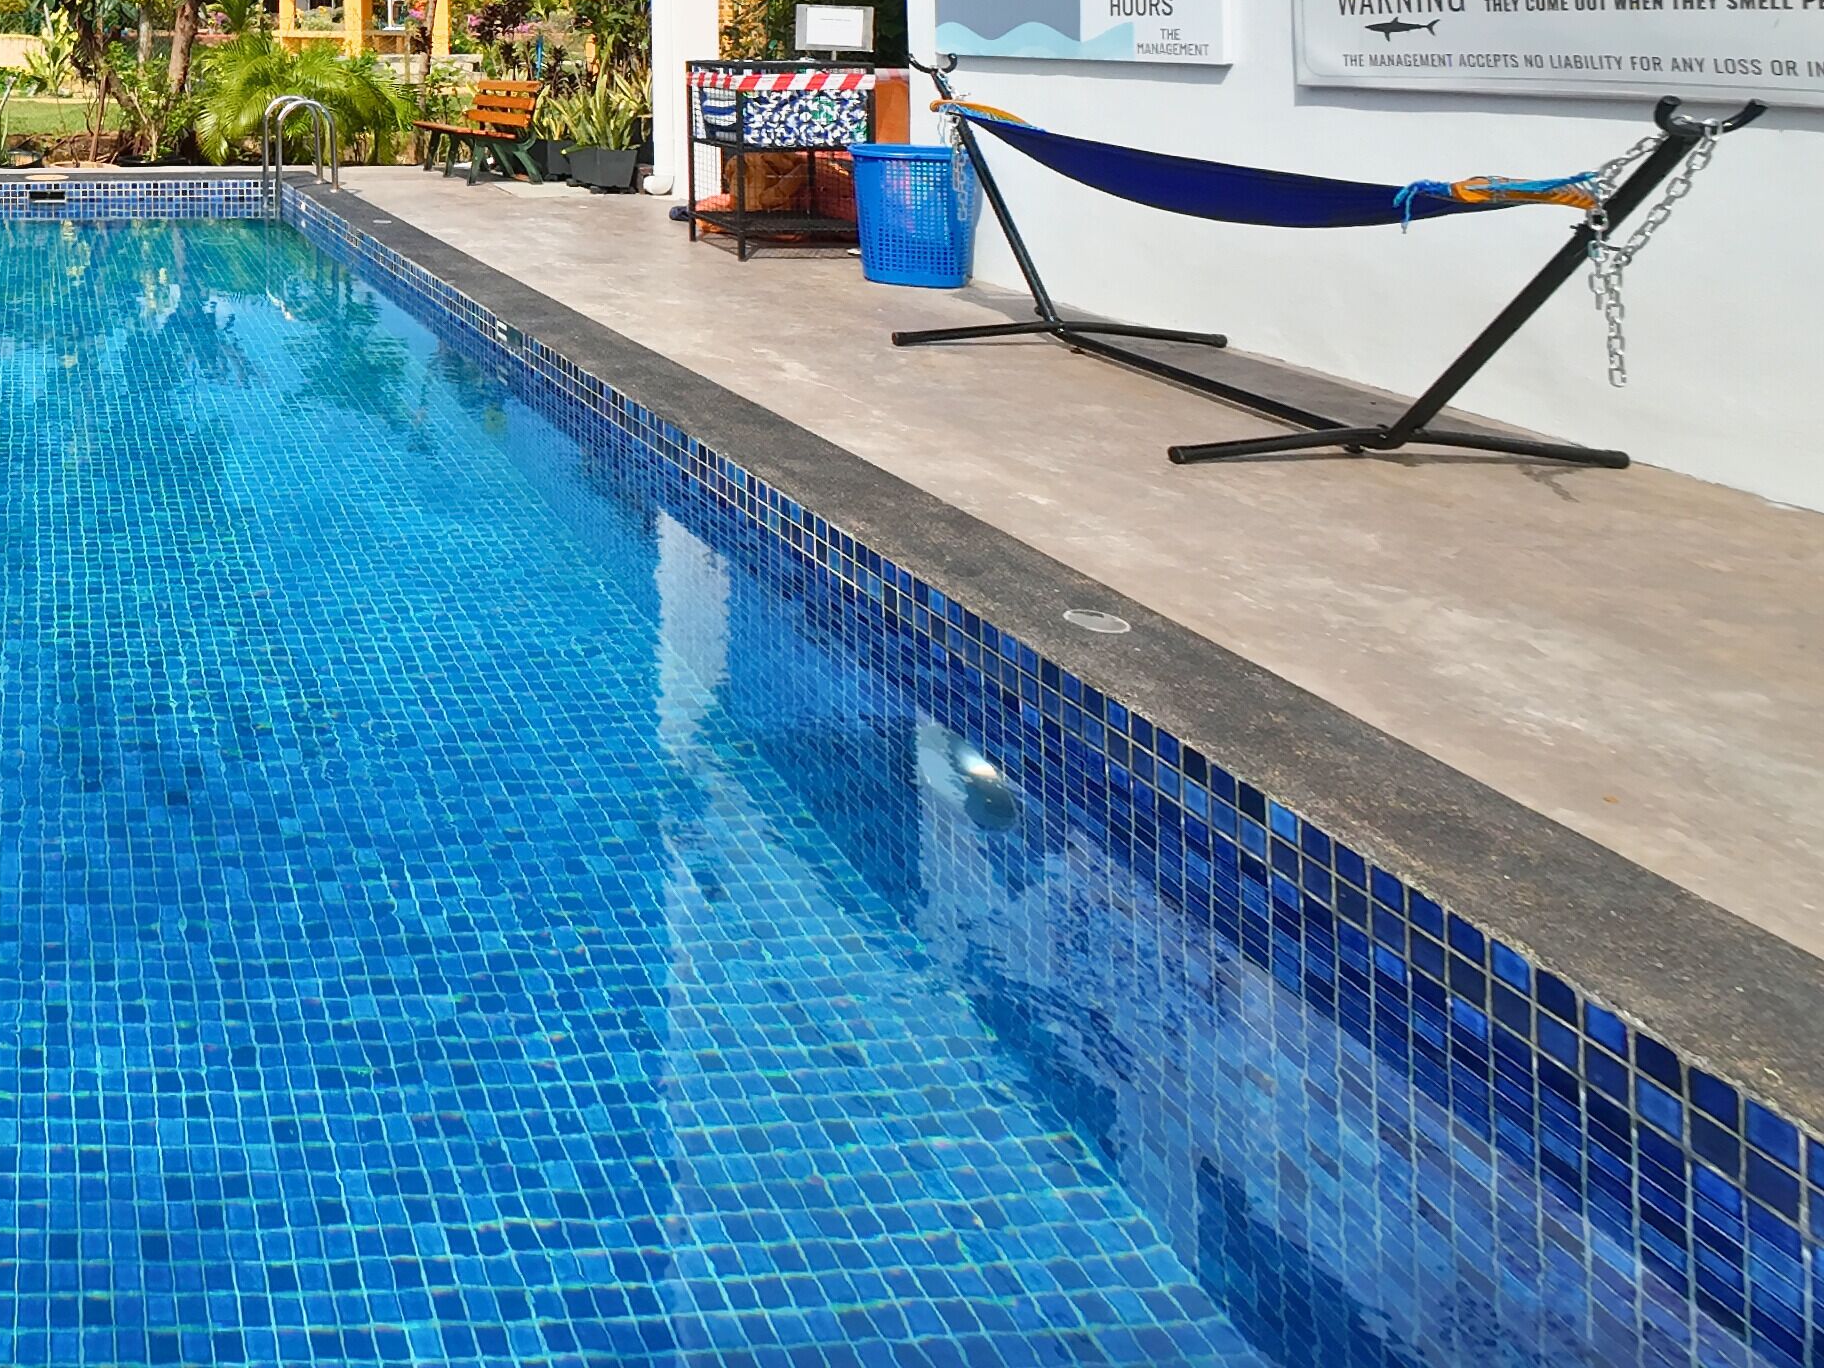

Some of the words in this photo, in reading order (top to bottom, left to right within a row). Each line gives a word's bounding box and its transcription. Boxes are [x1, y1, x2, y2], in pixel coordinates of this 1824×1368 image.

[1160, 28, 1180, 41] THE
[1137, 43, 1209, 56] MANAGEMENT
[1343, 54, 1365, 67] THE
[1369, 54, 1453, 68] MANAGEMENT
[1459, 54, 1519, 69] ACCEPTS
[1524, 55, 1544, 69] NO
[1548, 54, 1623, 71] LIABILITY
[1630, 56, 1664, 72] FOR
[1671, 57, 1705, 73] ANY
[1714, 57, 1762, 76] LOSS
[1771, 60, 1800, 77] OR
